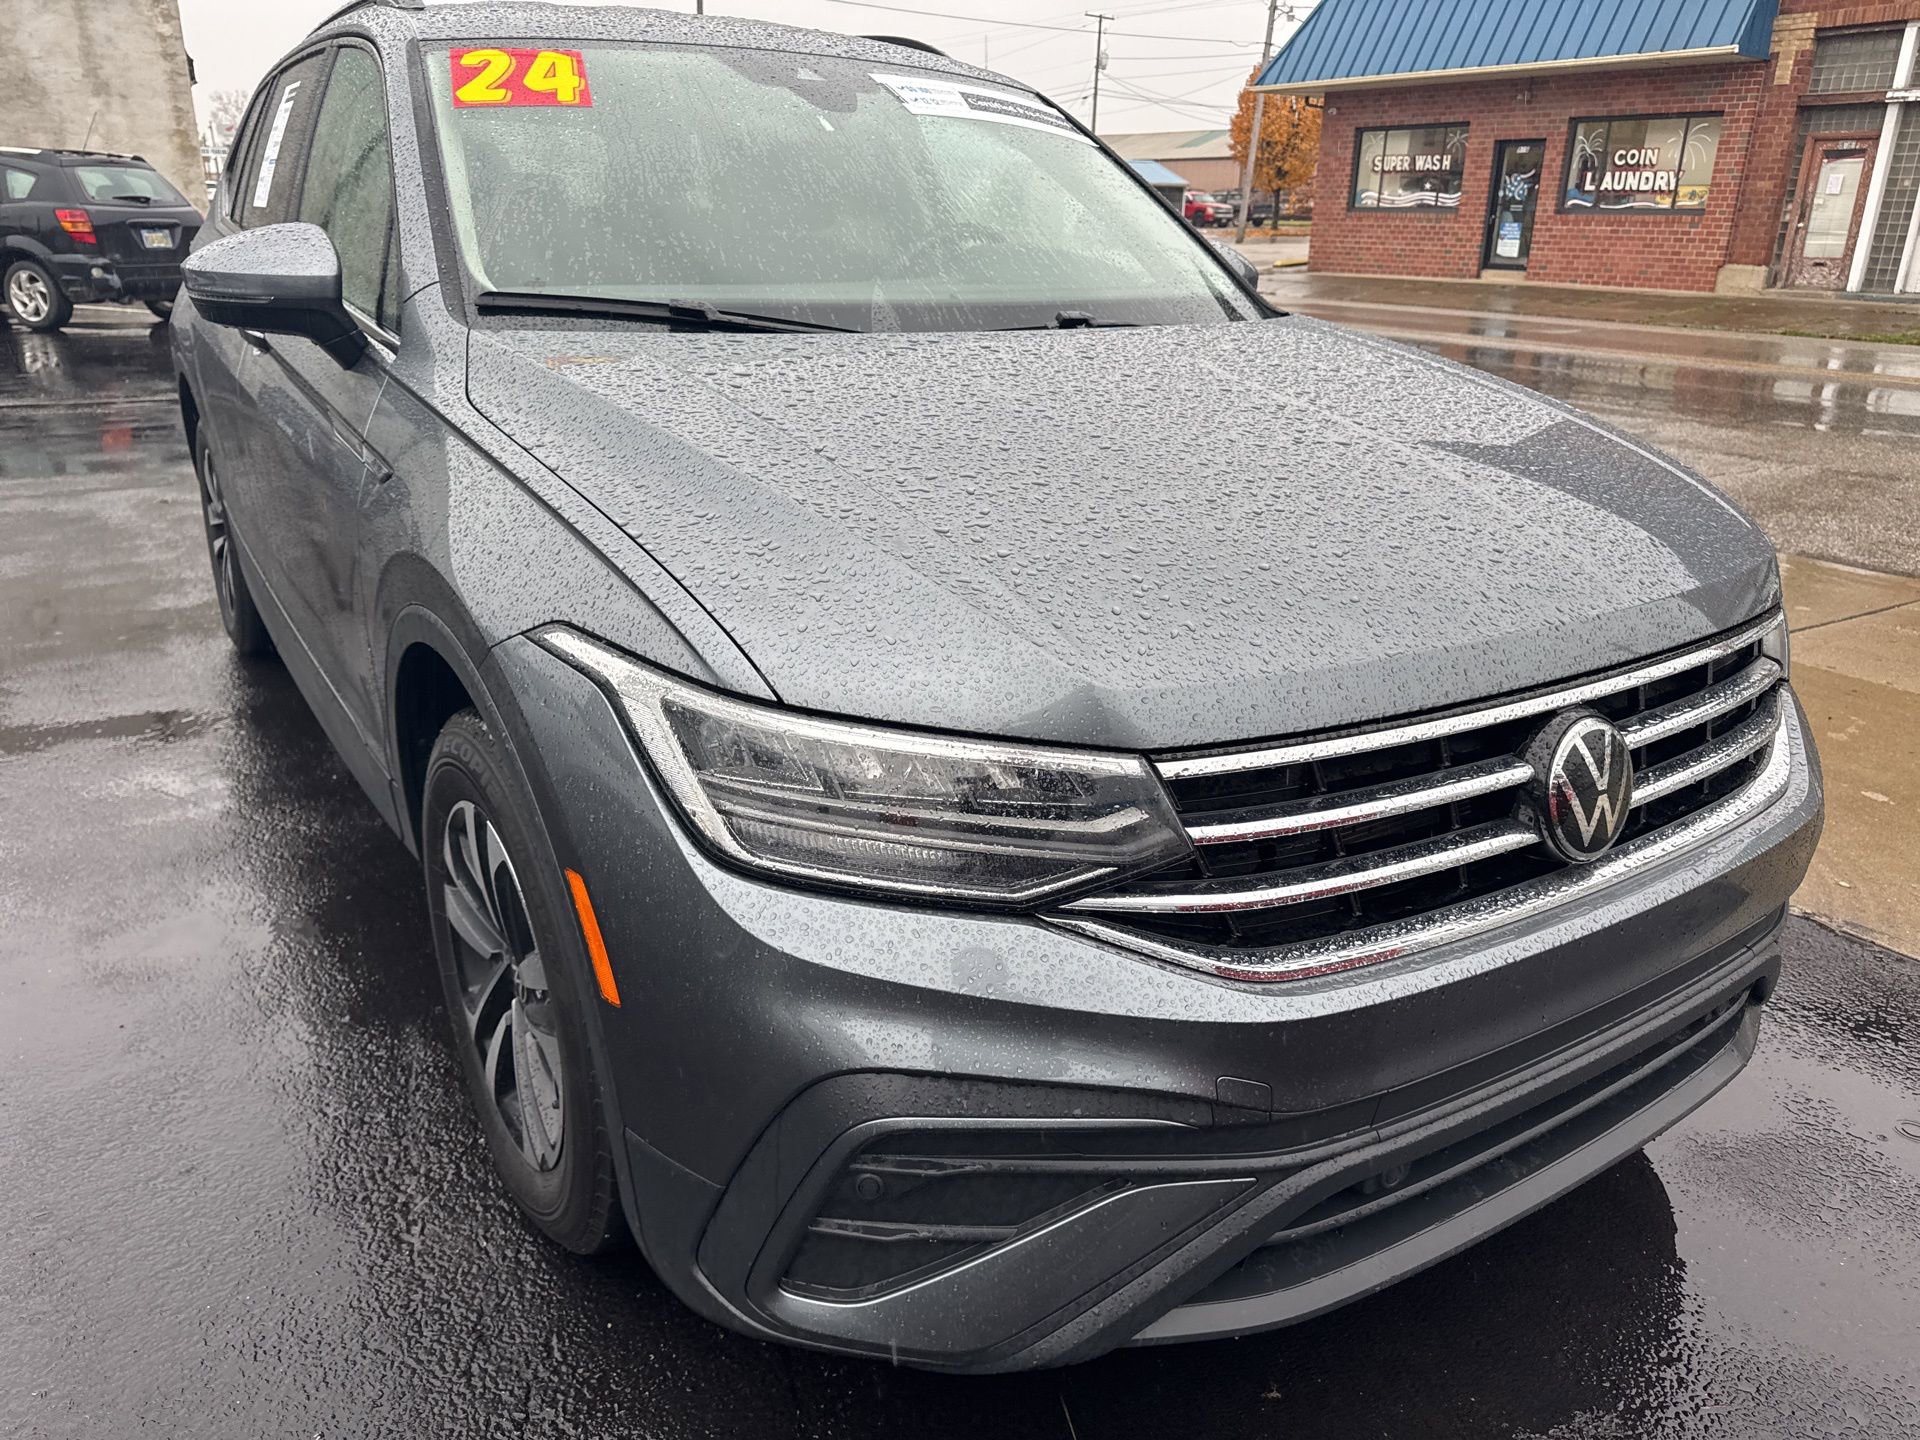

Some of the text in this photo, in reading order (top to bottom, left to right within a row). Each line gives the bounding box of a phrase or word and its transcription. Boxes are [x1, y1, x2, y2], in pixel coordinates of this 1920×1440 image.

[455, 48, 586, 105] 24
[1373, 154, 1452, 172] SUPER WASH
[1613, 148, 1659, 166] COIN
[1584, 170, 1684, 192] LAUNDRY
